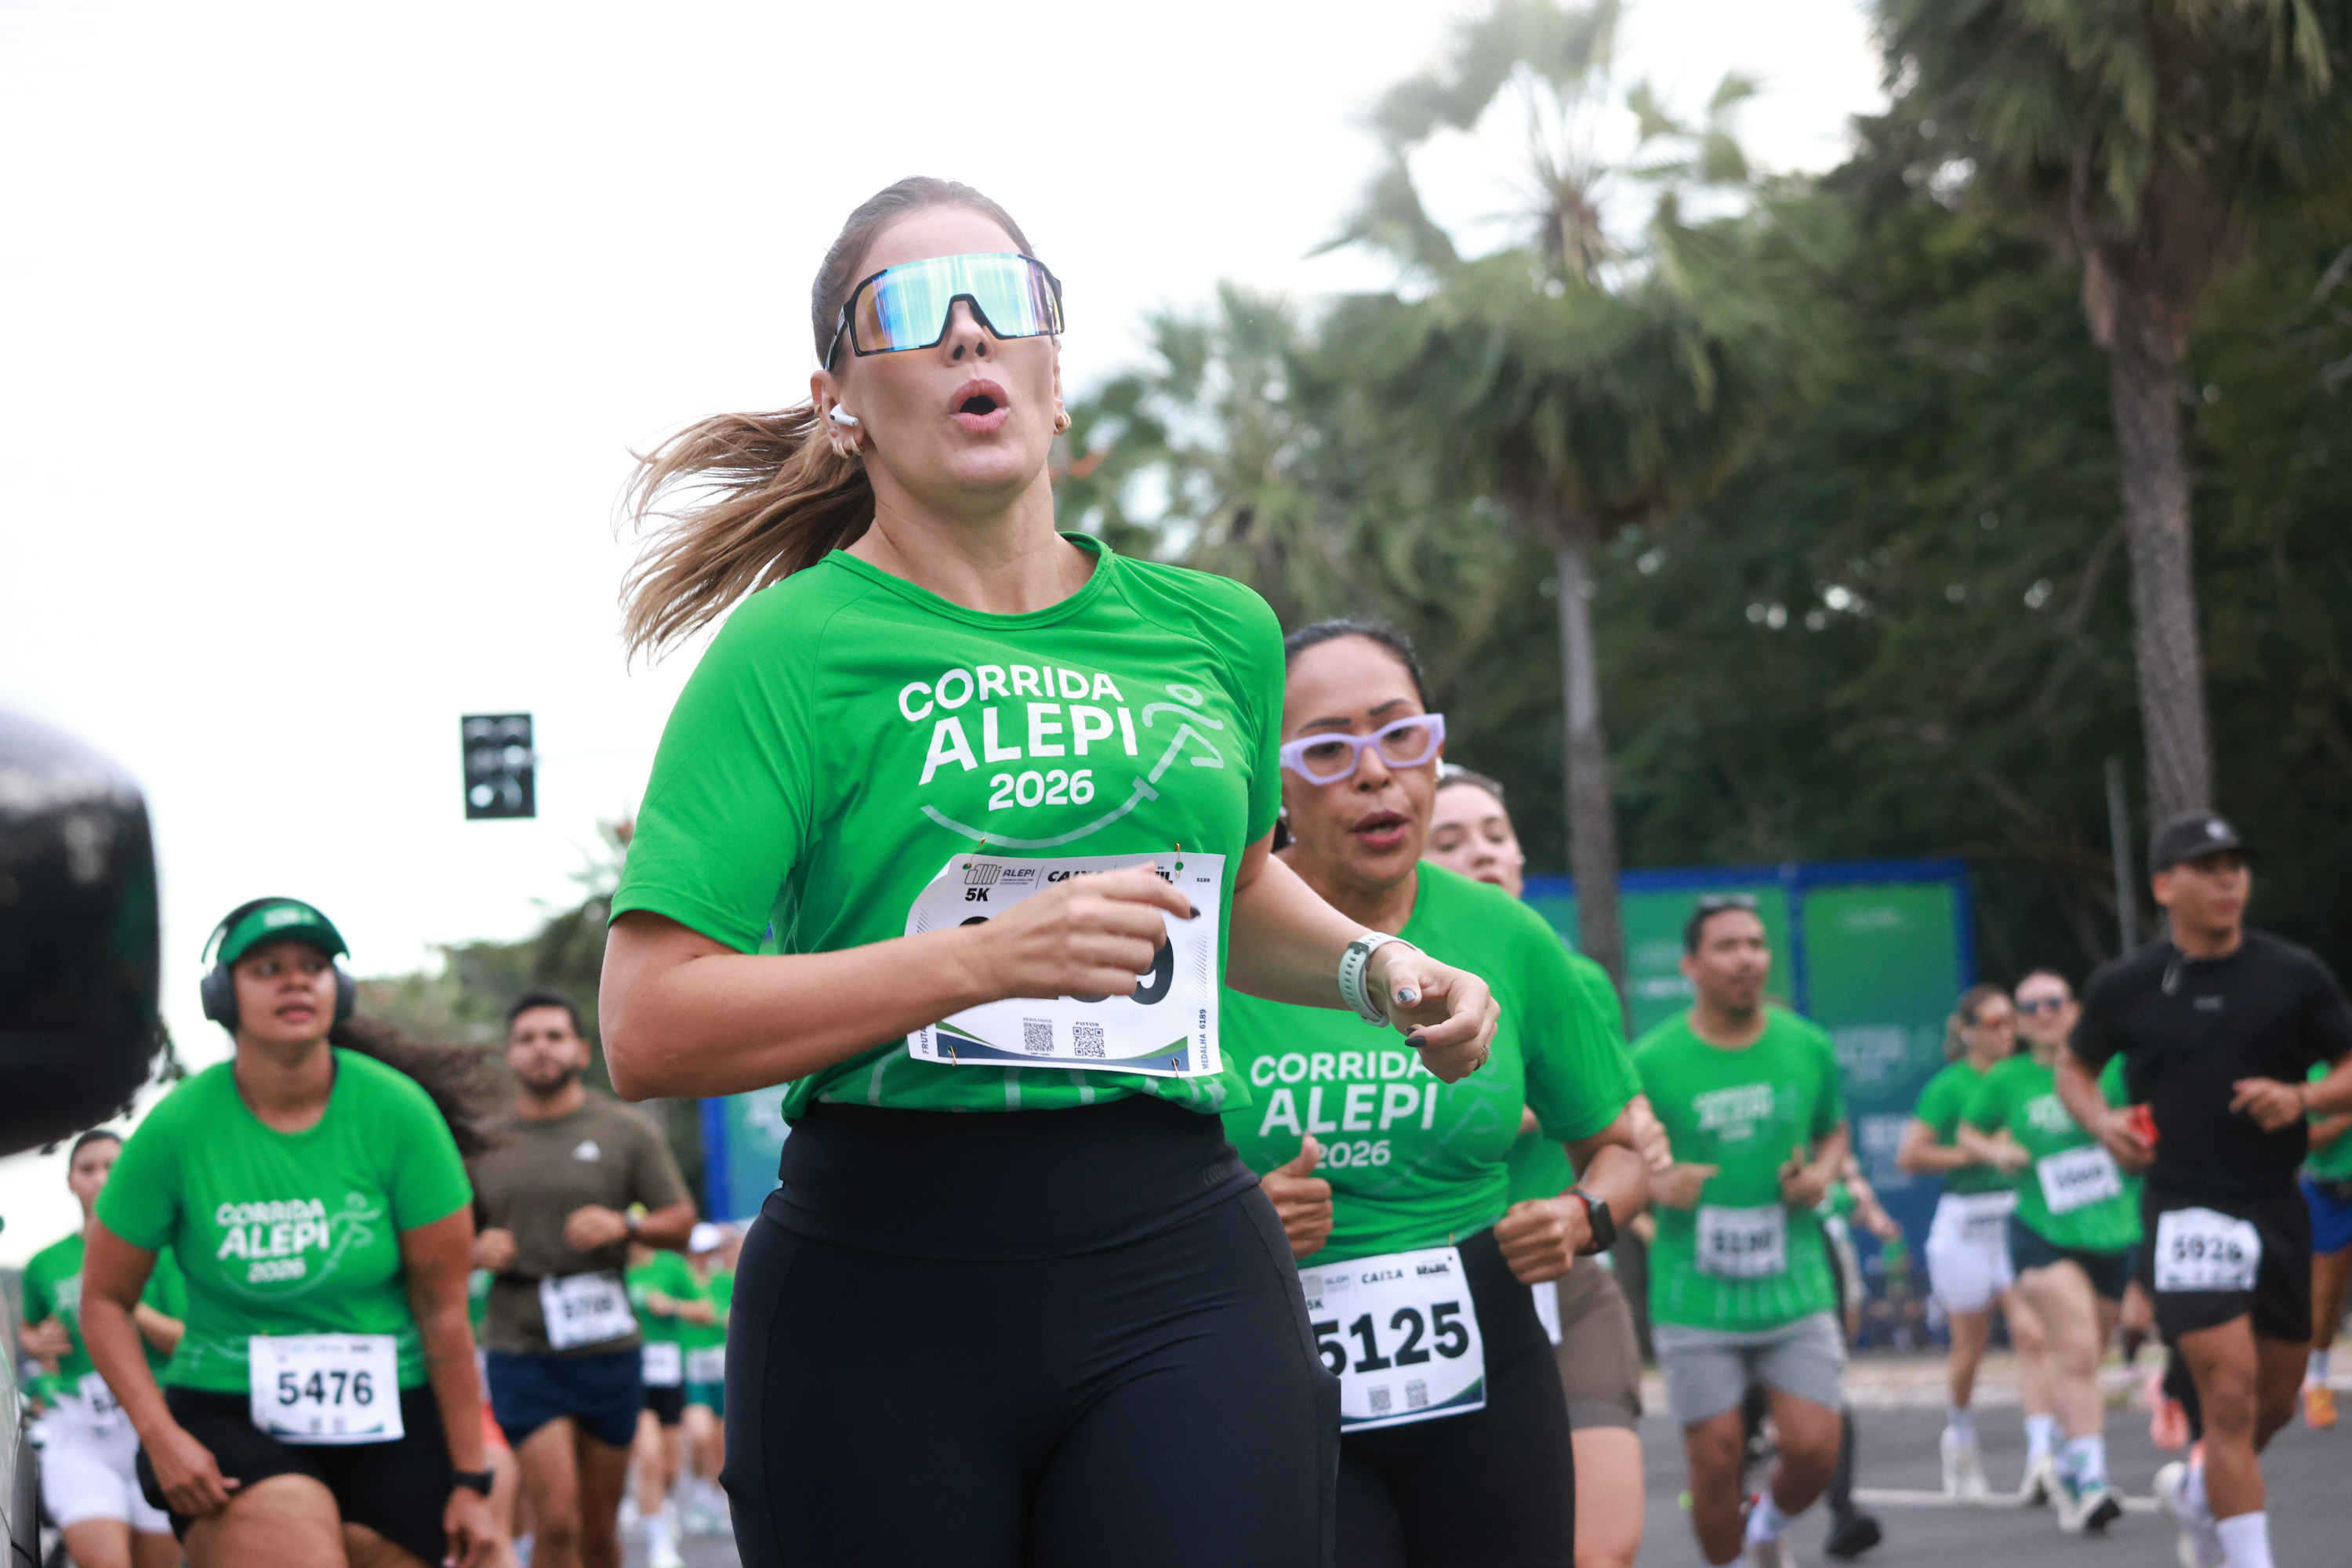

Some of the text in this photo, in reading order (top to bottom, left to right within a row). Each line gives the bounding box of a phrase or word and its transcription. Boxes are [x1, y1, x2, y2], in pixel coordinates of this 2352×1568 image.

[898, 664, 1124, 722] CORRIDA
[919, 702, 1138, 786] ALEPI
[989, 769, 1094, 811] 2026
[965, 887, 989, 902] 5K
[1200, 1033, 1209, 1069] MEDALHA
[1250, 1051, 1436, 1087] CORRIDA
[1258, 1083, 1438, 1137] ALEPI
[217, 1220, 330, 1261] ALEPI
[1362, 1269, 1404, 1283] CAIXA
[1312, 1301, 1469, 1377] 5125
[279, 1371, 374, 1406] 5476
